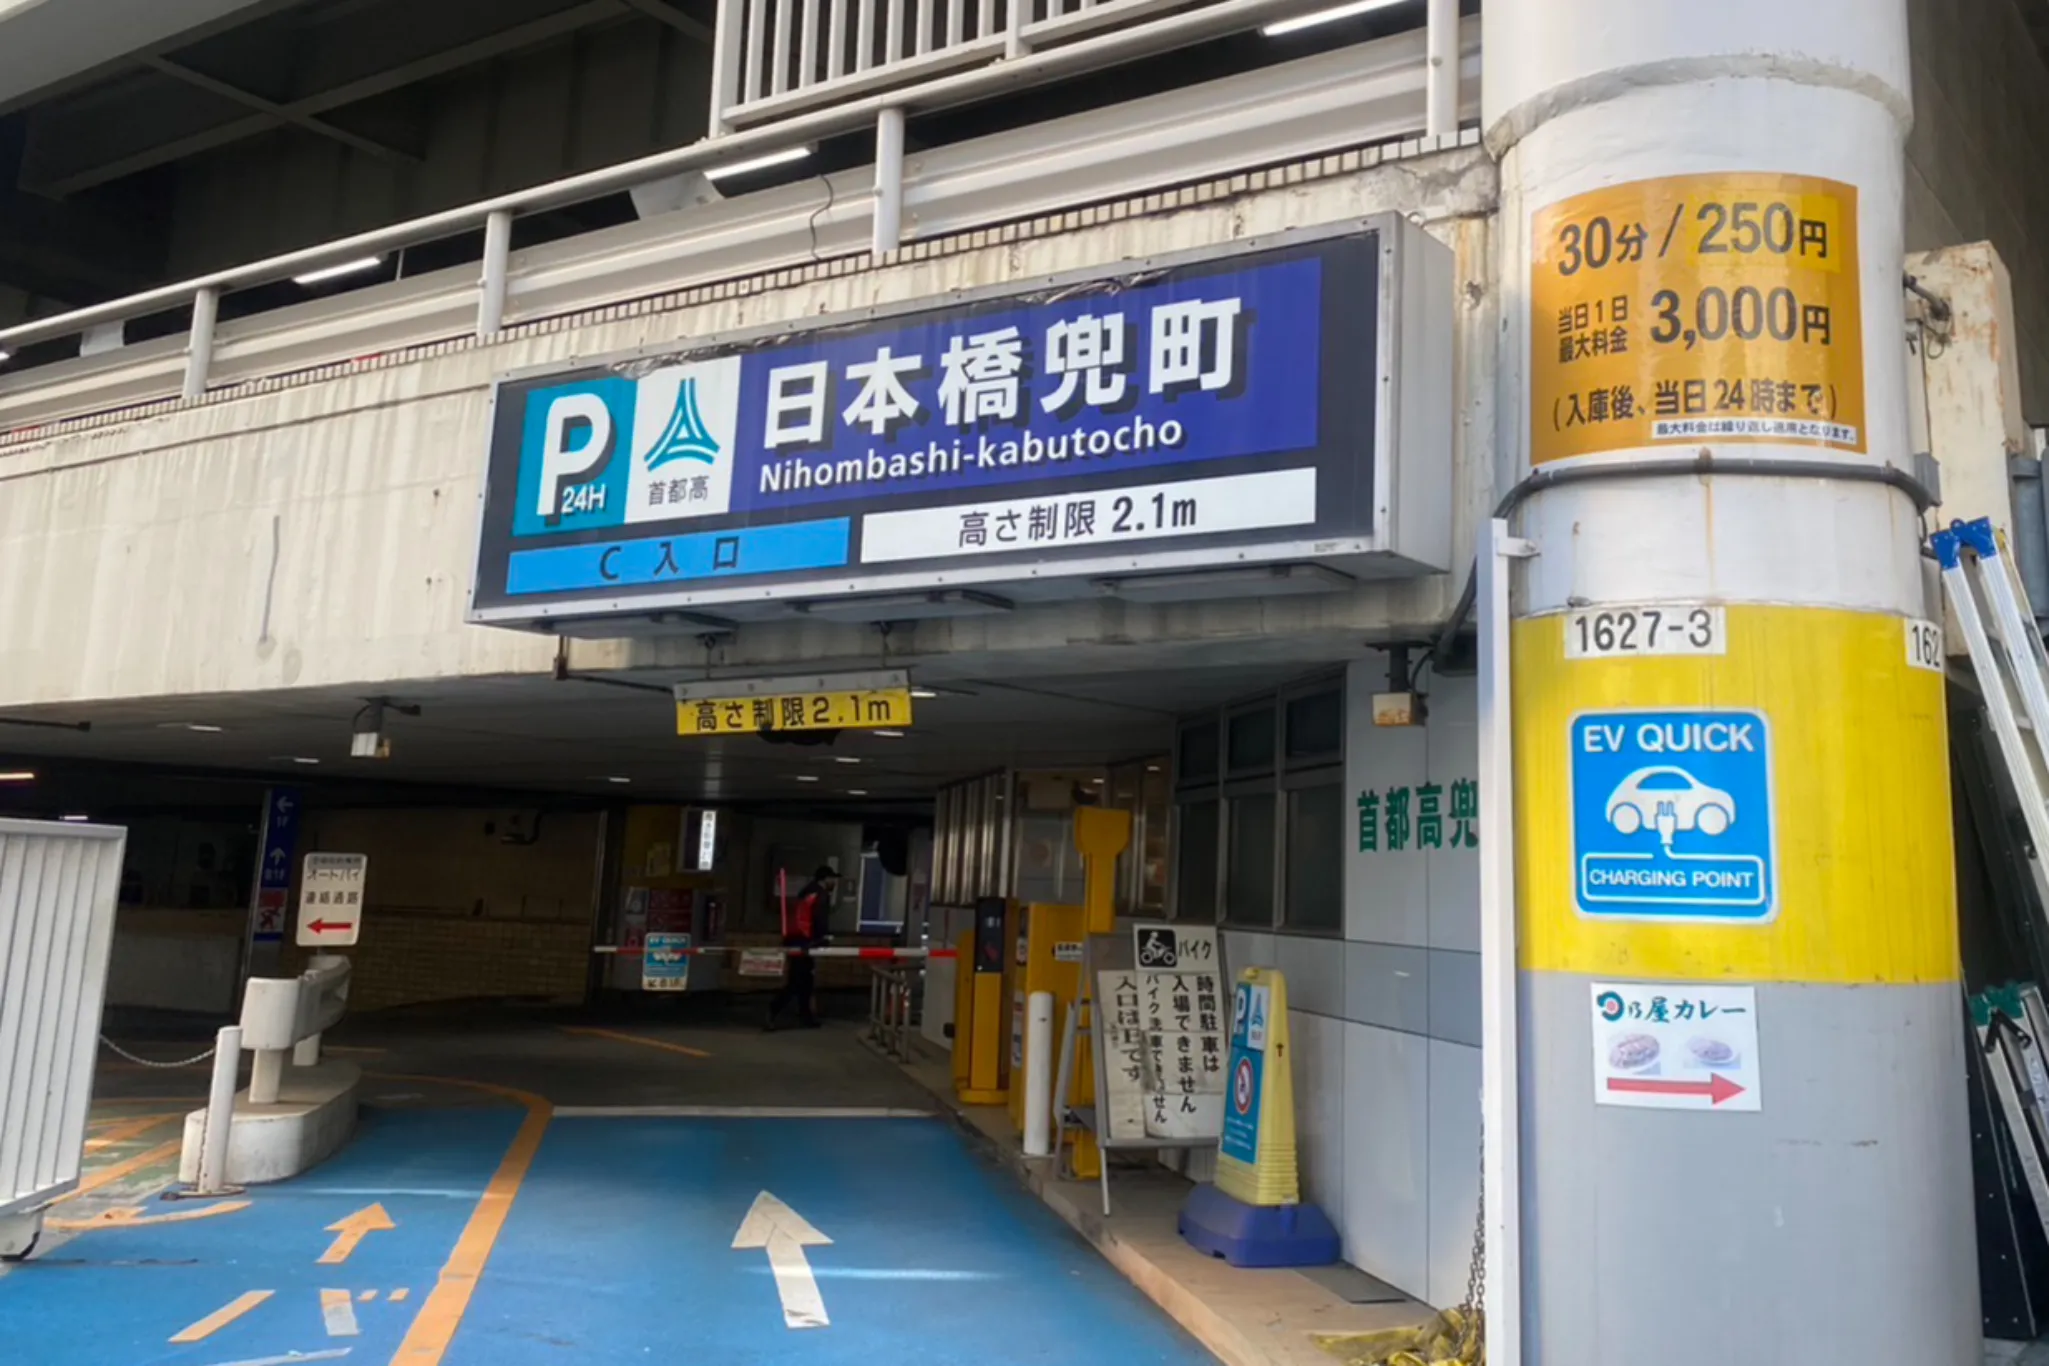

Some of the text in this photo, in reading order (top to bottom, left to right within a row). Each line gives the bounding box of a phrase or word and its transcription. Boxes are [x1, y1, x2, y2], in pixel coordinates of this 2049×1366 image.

[1558, 215, 1649, 276] 30分
[1697, 202, 1828, 258] 250円
[1650, 285, 1831, 351] 3,000円
[1558, 326, 1629, 364] 最大料金
[763, 297, 1241, 449] 日本橋兜町
[536, 393, 611, 515] P
[759, 415, 1182, 493] Nihombashi-kabutocho
[562, 485, 606, 514] 24H
[648, 476, 709, 505] 首都高
[959, 492, 1197, 548] 高さ制限 2.1m
[1575, 608, 1712, 652] 1627-3
[1584, 723, 1754, 753] EV QUICK
[1589, 868, 1754, 889] CHARGING POINT
[1178, 940, 1212, 960] バイク
